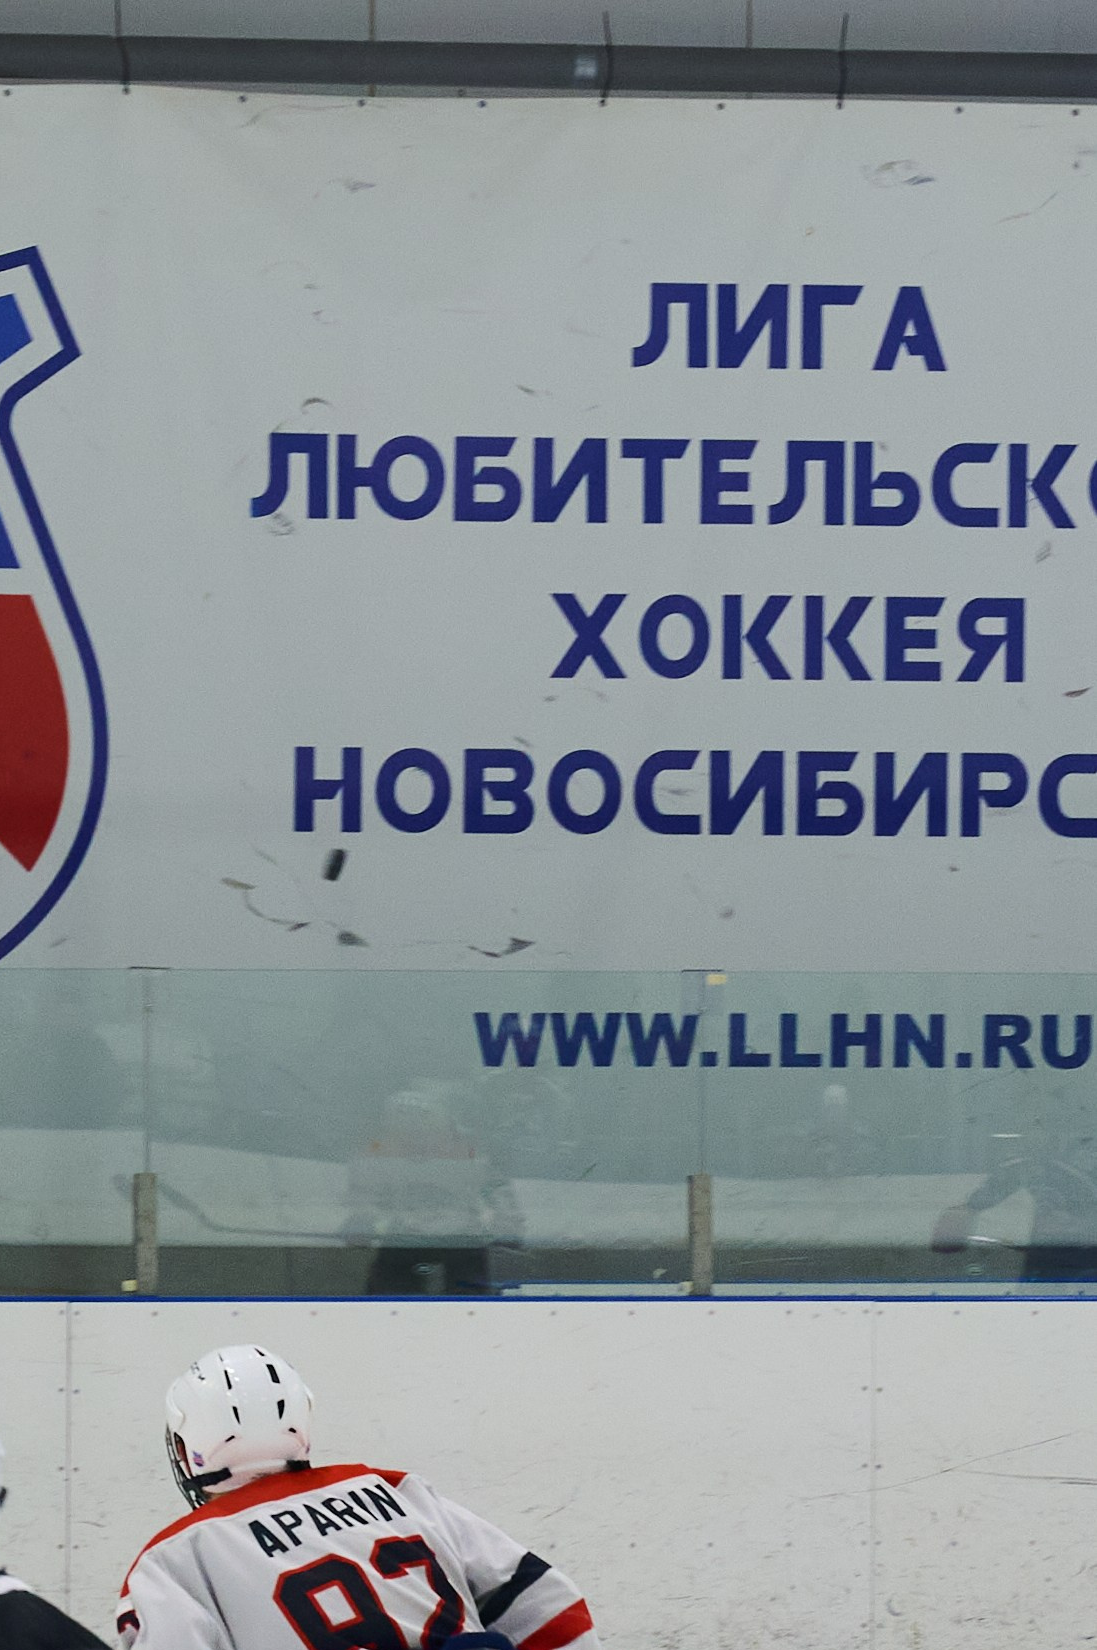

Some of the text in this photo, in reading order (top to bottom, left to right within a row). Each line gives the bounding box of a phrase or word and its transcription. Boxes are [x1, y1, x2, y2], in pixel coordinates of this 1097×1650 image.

[632, 282, 947, 372] ЛИГА
[250, 432, 1097, 529] ЛЮБИТЕЛЬСК
[551, 592, 1025, 683] ХОККЕЯ
[293, 746, 1097, 839] НОВОСИБИРС
[472, 1011, 1095, 1070] WWW.LLHN.RU
[248, 1483, 407, 1558] APARIN
